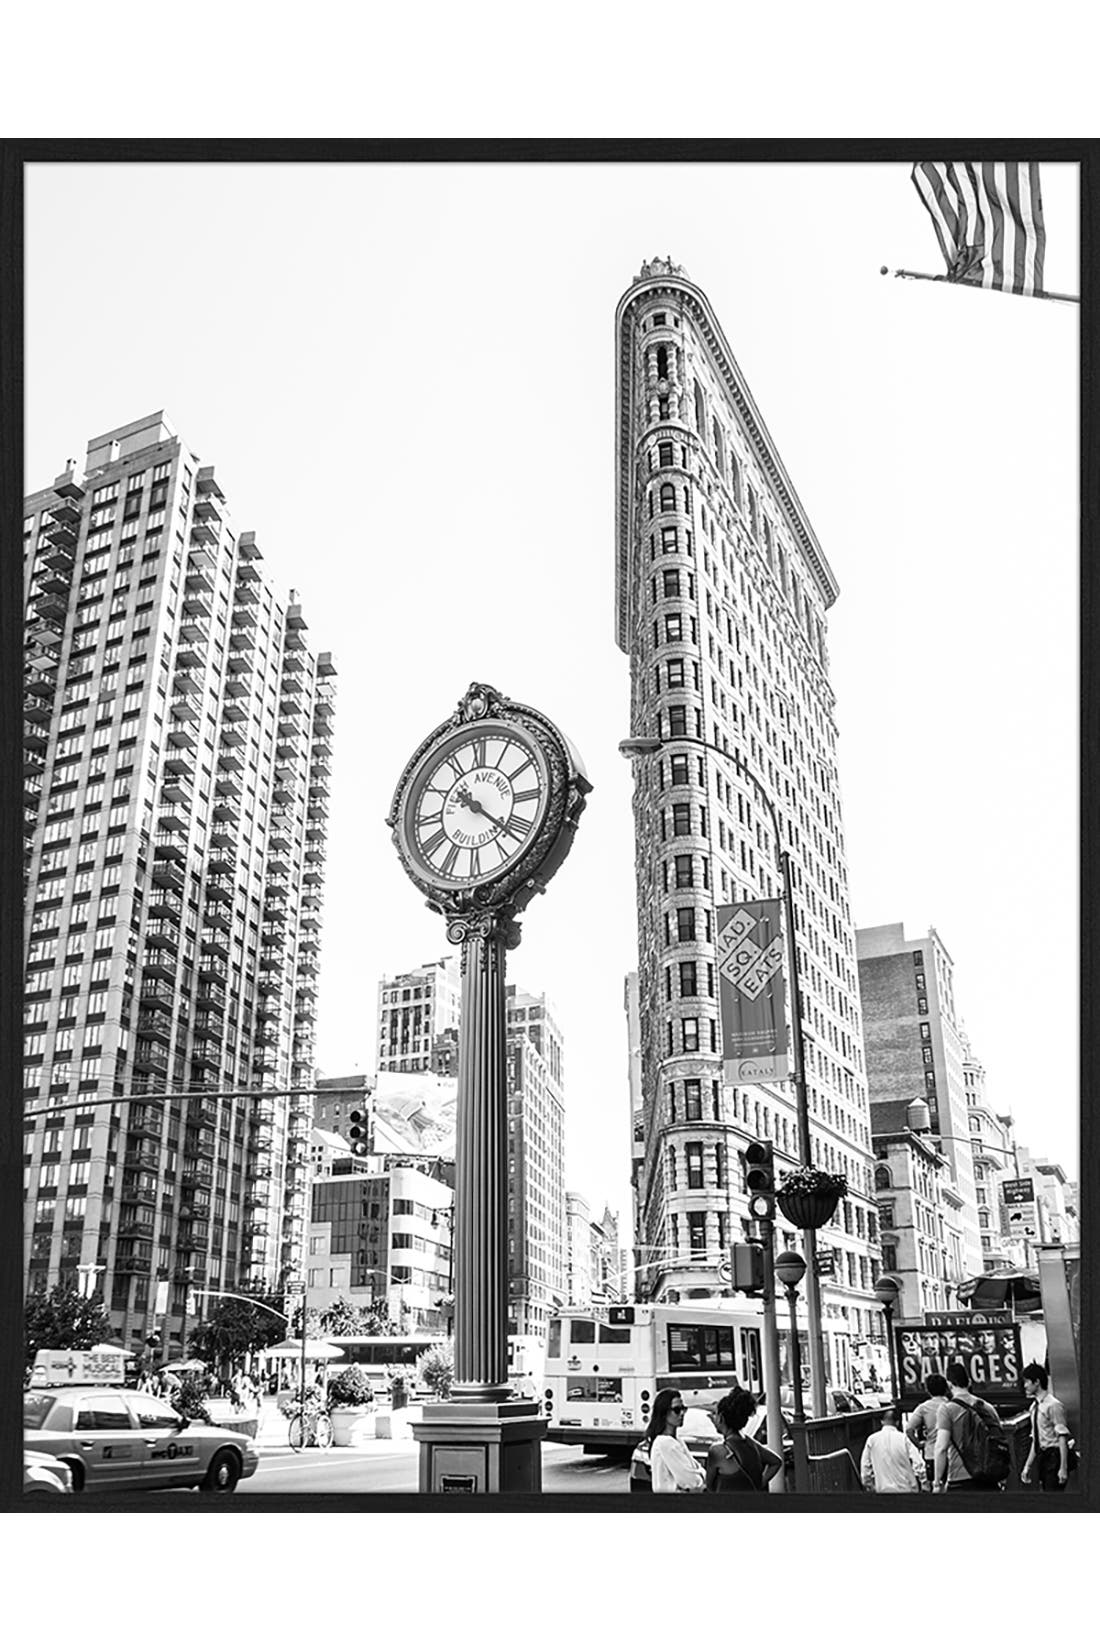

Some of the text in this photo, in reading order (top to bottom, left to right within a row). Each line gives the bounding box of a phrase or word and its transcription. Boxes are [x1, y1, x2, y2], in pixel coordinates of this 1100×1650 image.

[473, 771, 511, 801] AVENUE
[451, 824, 503, 846] BUILDIN
[718, 920, 751, 954] AD.
[727, 948, 757, 978] SQ.
[743, 947, 783, 996] EATS
[82, 1363, 121, 1374] MUSICAL
